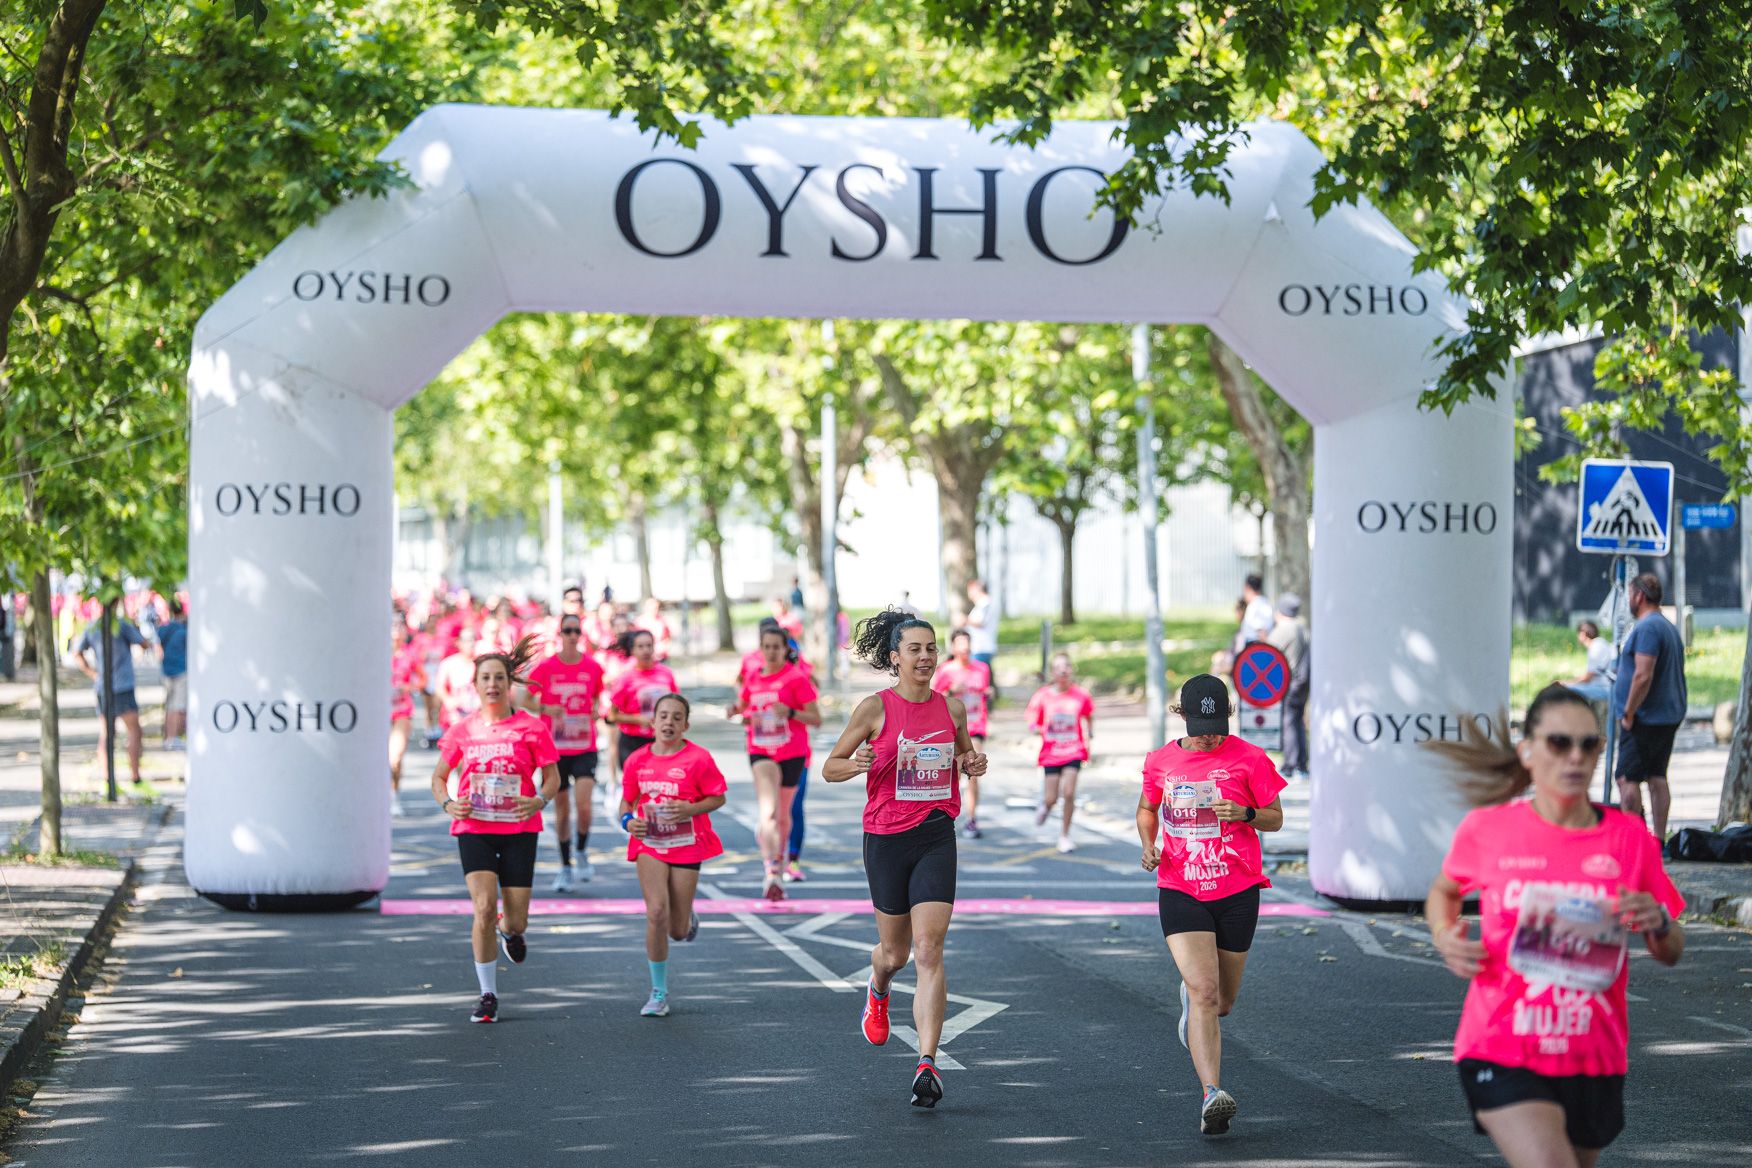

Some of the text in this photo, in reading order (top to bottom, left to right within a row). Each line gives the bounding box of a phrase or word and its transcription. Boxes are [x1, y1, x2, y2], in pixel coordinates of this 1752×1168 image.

[613, 158, 1131, 266] OYSHO
[292, 269, 451, 308] OYSHO
[1278, 283, 1429, 317] OYSHO
[215, 483, 362, 517] OYSHO
[1357, 501, 1498, 535] OYSHO
[212, 700, 359, 734] OYSHO
[467, 742, 515, 759] CARRERA
[917, 770, 939, 779] 016
[484, 795, 504, 805] 016
[1174, 808, 1197, 817] 016
[1184, 862, 1229, 880] MUJER
[1200, 880, 1218, 891] 2026
[1512, 998, 1593, 1036] MUJER
